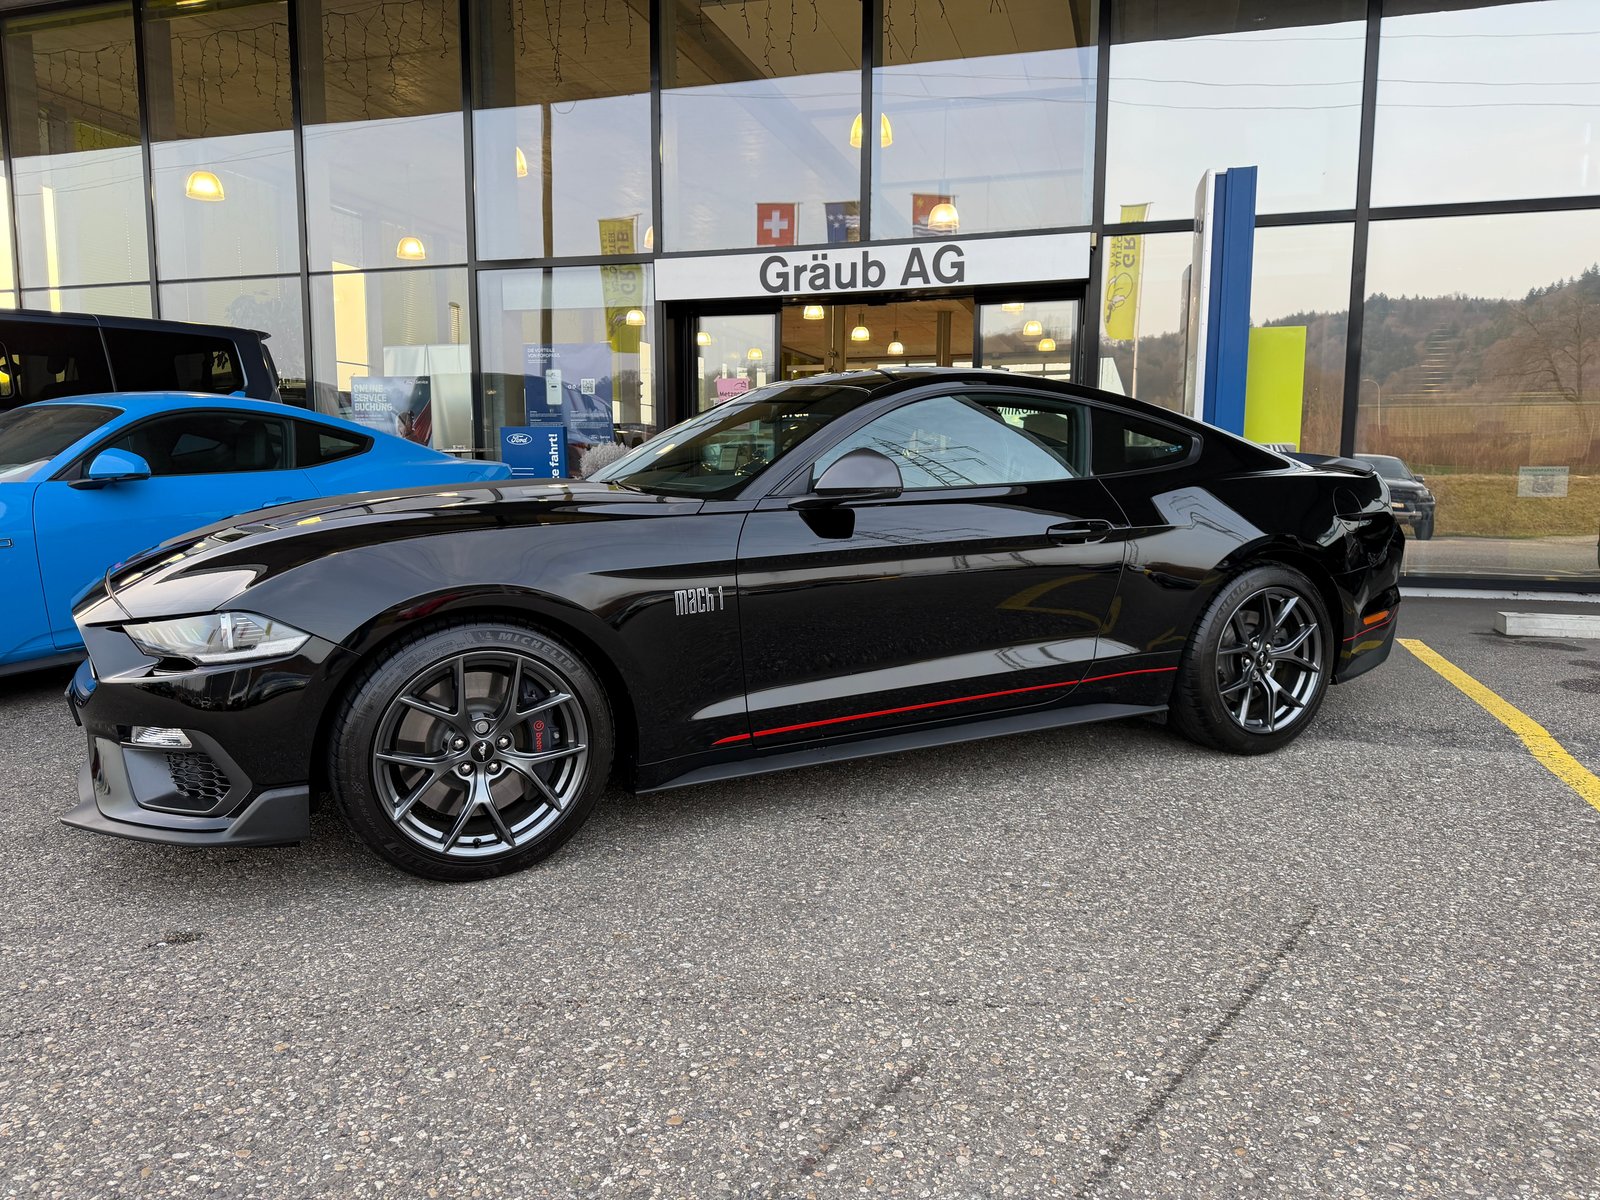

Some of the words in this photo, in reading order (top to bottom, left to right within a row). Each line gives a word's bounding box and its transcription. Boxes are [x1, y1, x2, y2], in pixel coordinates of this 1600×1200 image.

[759, 250, 886, 294] Gräub
[899, 244, 965, 286] AG
[353, 384, 384, 393] ONLINE
[354, 393, 388, 403] SERVICE
[354, 402, 393, 412] BUCHUNG
[509, 434, 530, 444] Ford
[548, 433, 559, 467] fahrt!
[718, 585, 724, 611] 1
[497, 632, 576, 671] MICHELIN
